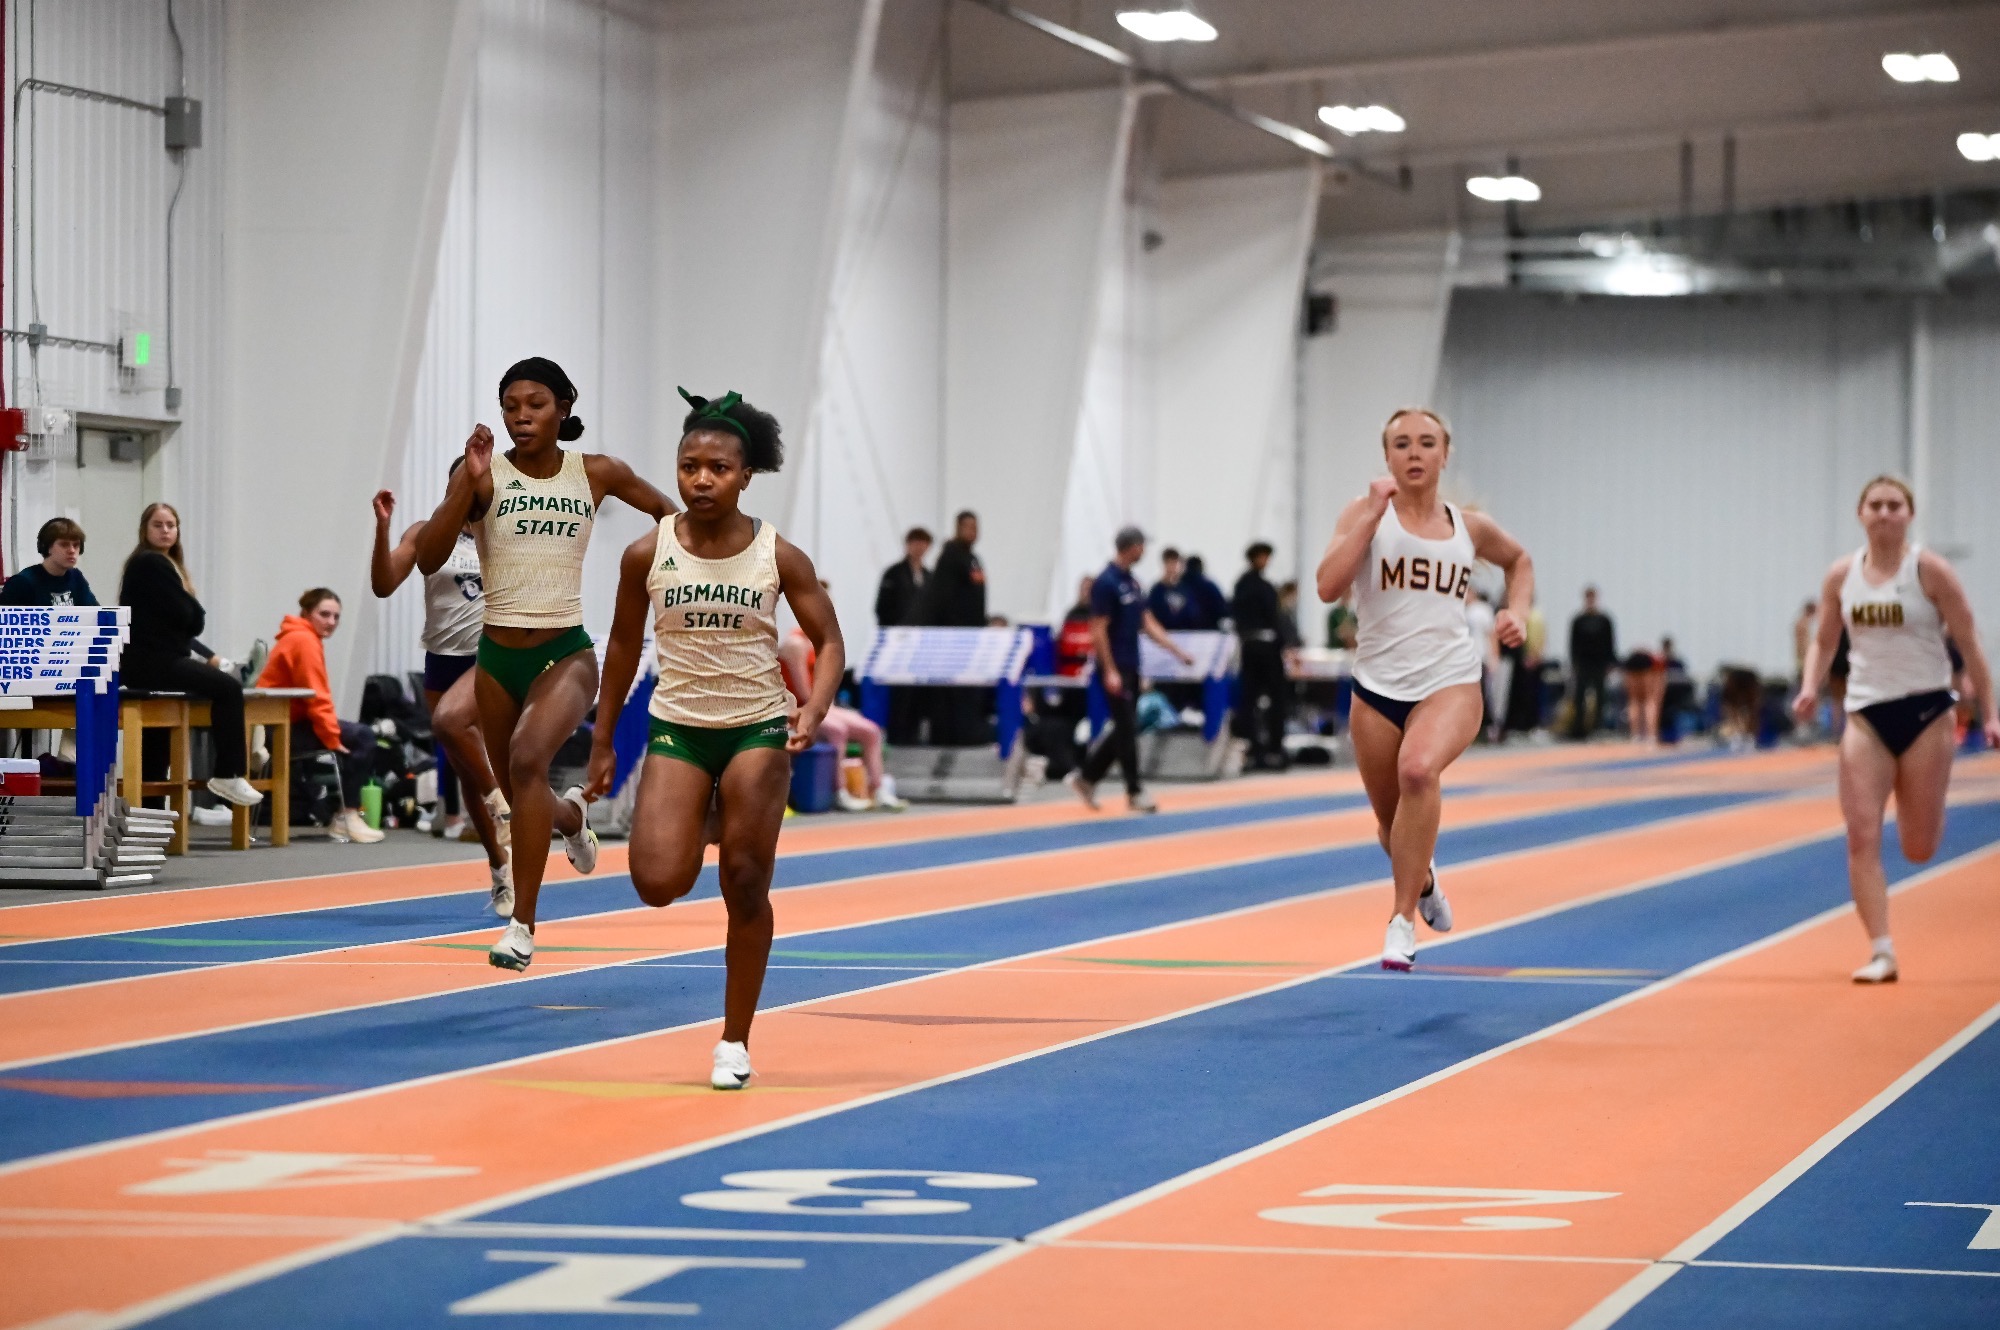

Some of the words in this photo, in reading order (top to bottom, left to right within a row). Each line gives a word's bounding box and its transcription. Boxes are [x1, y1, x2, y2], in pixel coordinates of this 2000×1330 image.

[496, 495, 592, 521] BISMARCK
[514, 519, 580, 537] STATE
[1381, 556, 1472, 599] MSUB
[664, 583, 763, 610] BISMARCK
[57, 615, 79, 623] GILL
[684, 612, 744, 629] STATE
[1852, 602, 1904, 627] MSUB
[0, 638, 44, 648] DERS
[0, 666, 33, 679] ERS
[40, 669, 62, 677] GILL
[121, 1151, 482, 1196] 4
[680, 1168, 1038, 1215] 3
[1257, 1183, 1623, 1232] 2
